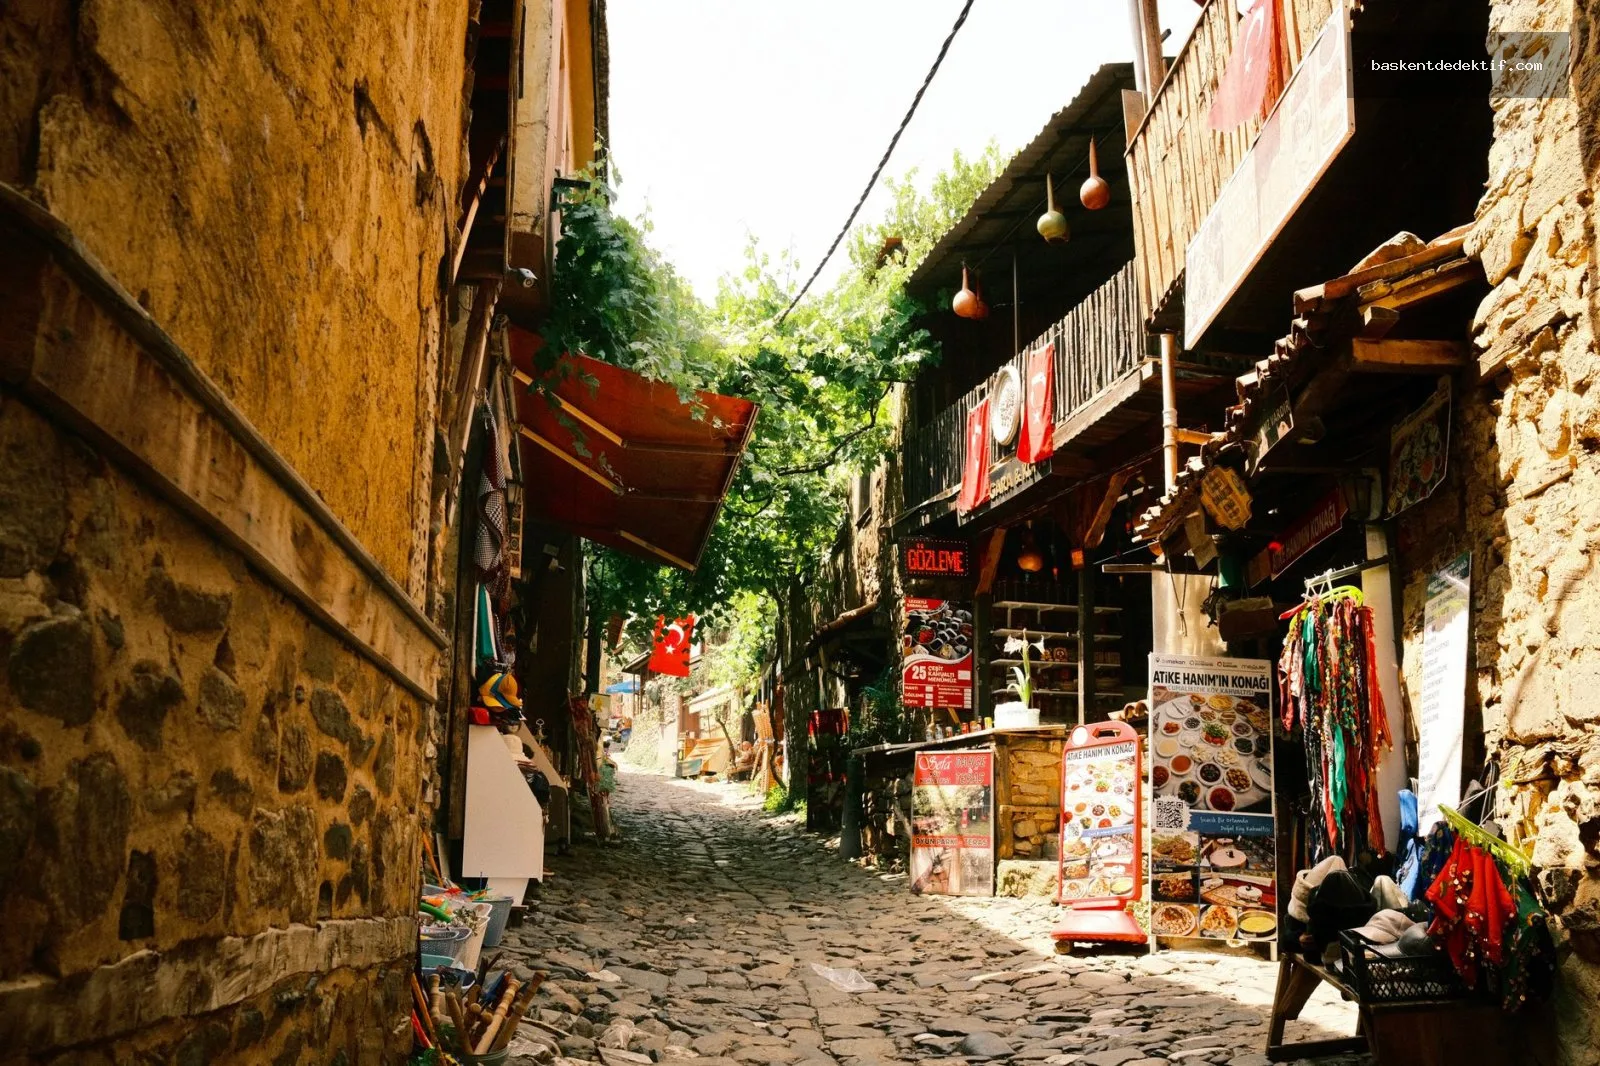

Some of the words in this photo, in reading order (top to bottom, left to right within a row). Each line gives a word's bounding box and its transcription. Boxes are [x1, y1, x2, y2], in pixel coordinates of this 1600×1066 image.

[907, 543, 964, 572] GÖZLEME
[911, 665, 927, 680] 25
[1231, 675, 1269, 690] KONAĞI
[1111, 742, 1135, 755] KONAĞI
[915, 837, 935, 845] OYUN
